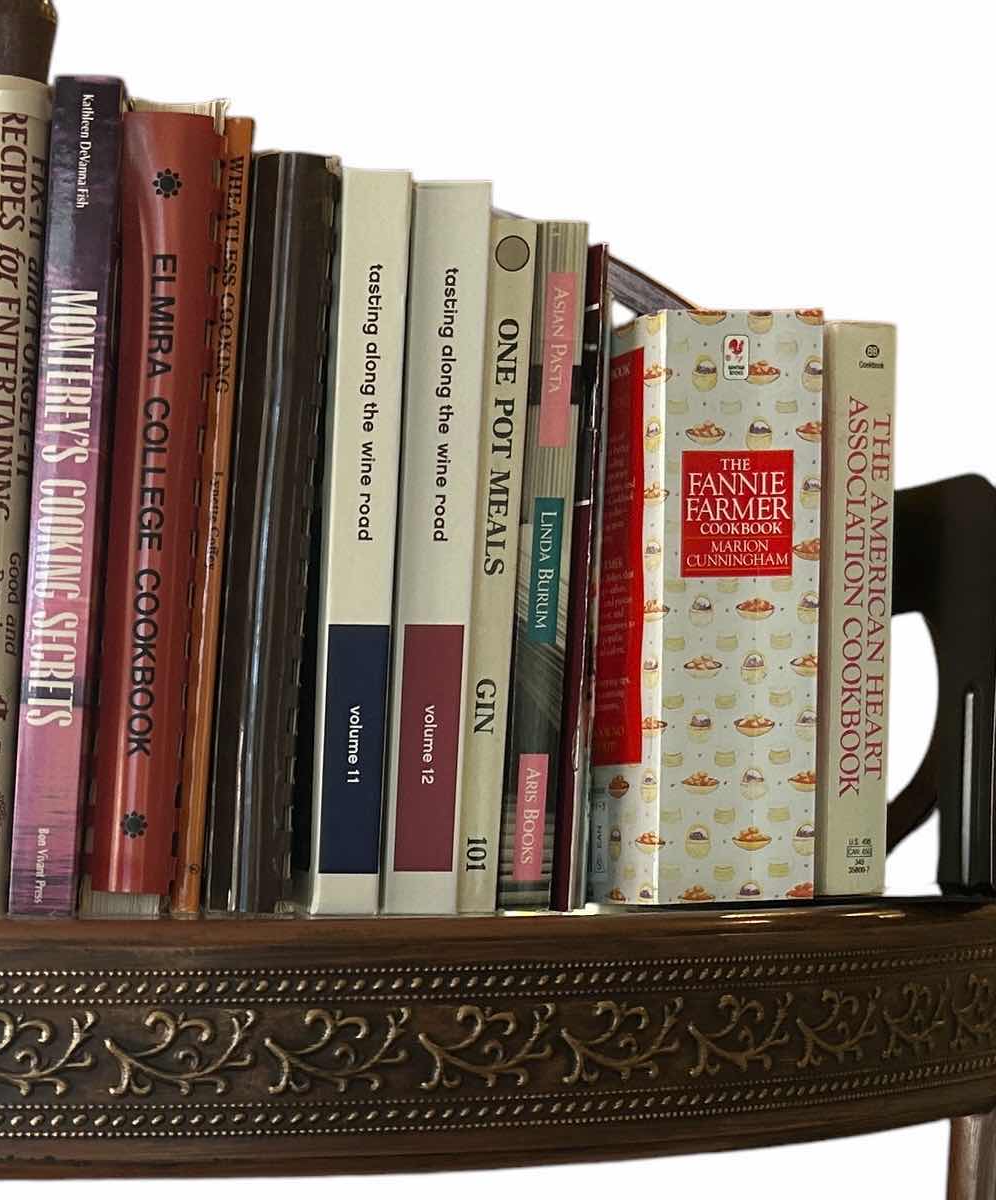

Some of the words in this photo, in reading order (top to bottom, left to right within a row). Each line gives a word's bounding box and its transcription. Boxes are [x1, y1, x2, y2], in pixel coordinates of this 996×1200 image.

[80, 94, 95, 137] Kathleen
[78, 141, 92, 185] DeVanna
[77, 189, 90, 208] Fish
[148, 254, 176, 377] ELMIRA
[363, 264, 384, 335] tasting
[552, 287, 569, 337] ASIAN
[43, 289, 98, 462] MONTEREY'S
[360, 342, 380, 396] along
[496, 318, 519, 384] ONE
[549, 344, 566, 392] PASTA
[362, 402, 378, 432] the
[492, 397, 515, 458] POT
[138, 398, 170, 551] COLLEGE
[361, 441, 374, 486] wine
[720, 459, 750, 470] THE
[871, 415, 891, 482] THE
[686, 498, 788, 520] FARMER
[689, 472, 786, 495] FANNIE
[843, 396, 868, 607] ASSOCIATION
[35, 479, 87, 599] COOKING
[357, 493, 372, 541] road
[484, 470, 511, 576] MEALS
[539, 511, 558, 562] LINDA
[701, 523, 782, 534] COOKBOOK
[687, 555, 788, 567] CUNNINGHAM
[711, 540, 768, 552] MARION
[536, 568, 554, 628] BURUM
[867, 492, 889, 663] AMERICAN
[26, 611, 79, 727] SECRETS
[127, 569, 161, 757] COOKBOOK
[422, 705, 437, 763] volume
[474, 679, 496, 734] GIN
[839, 617, 861, 798] COOKBOOK
[866, 675, 884, 780] HEART
[348, 706, 363, 764] volume
[347, 769, 359, 783] 11
[421, 768, 434, 784] 12
[524, 768, 540, 802] ARIS
[521, 809, 539, 864] BOOKS
